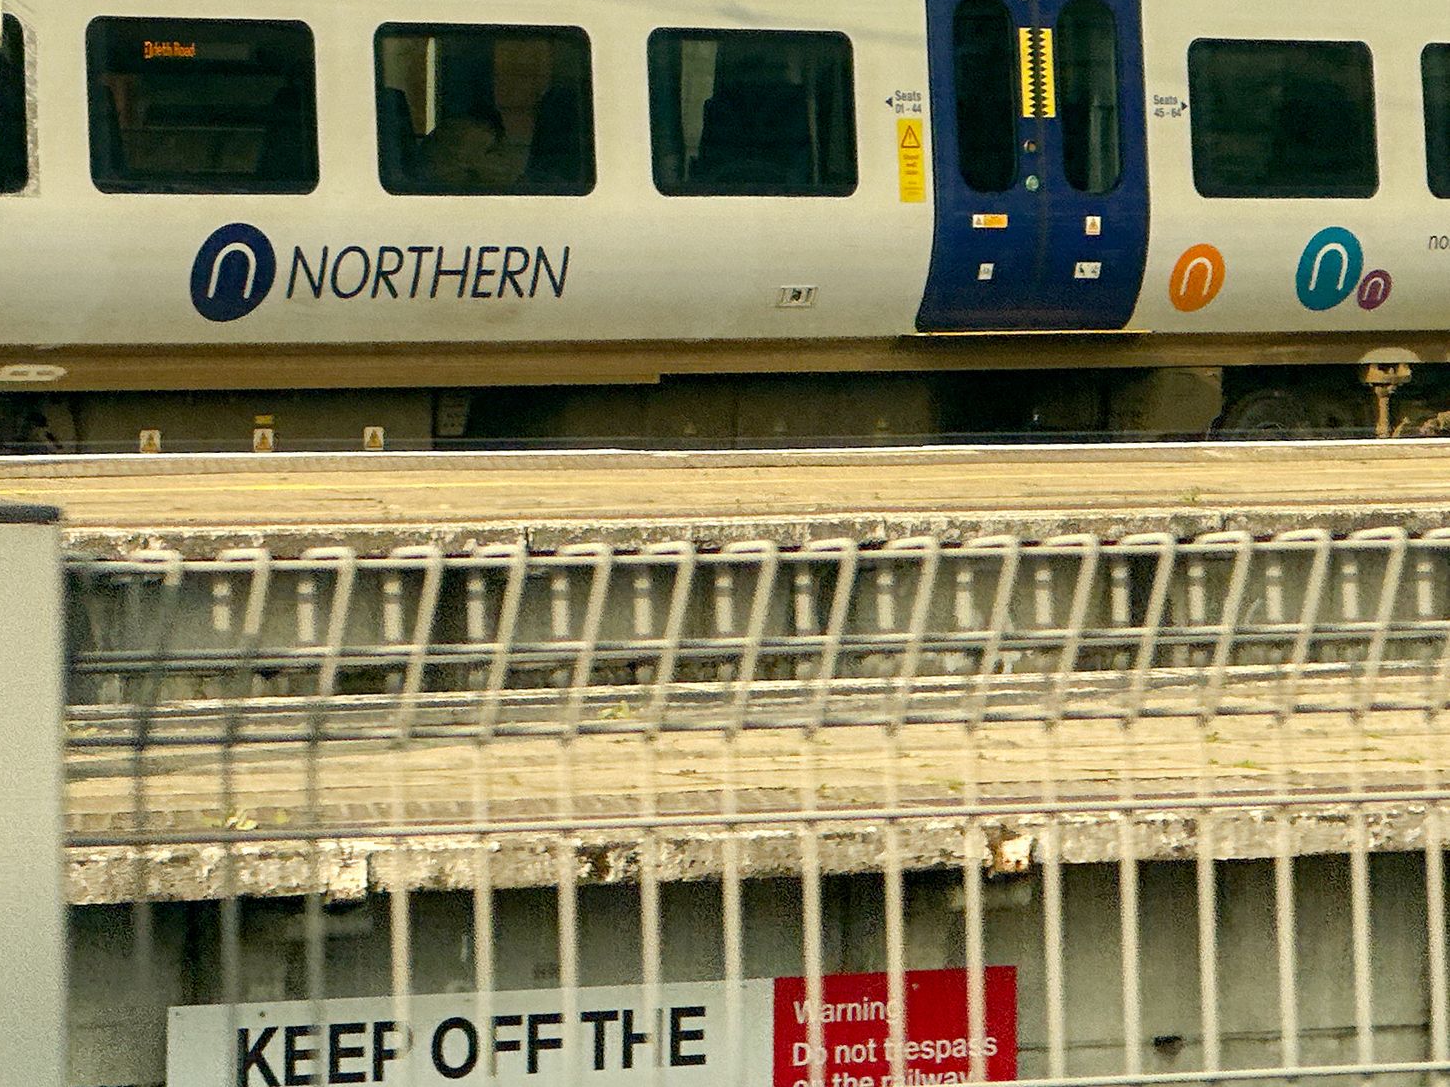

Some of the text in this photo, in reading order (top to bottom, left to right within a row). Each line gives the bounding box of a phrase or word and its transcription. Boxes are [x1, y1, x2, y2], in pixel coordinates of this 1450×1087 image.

[895, 90, 921, 102] Seats
[286, 245, 570, 300] NORTHERN
[237, 1005, 707, 1087] KEEP OFF THE
[834, 1038, 877, 1064] not
